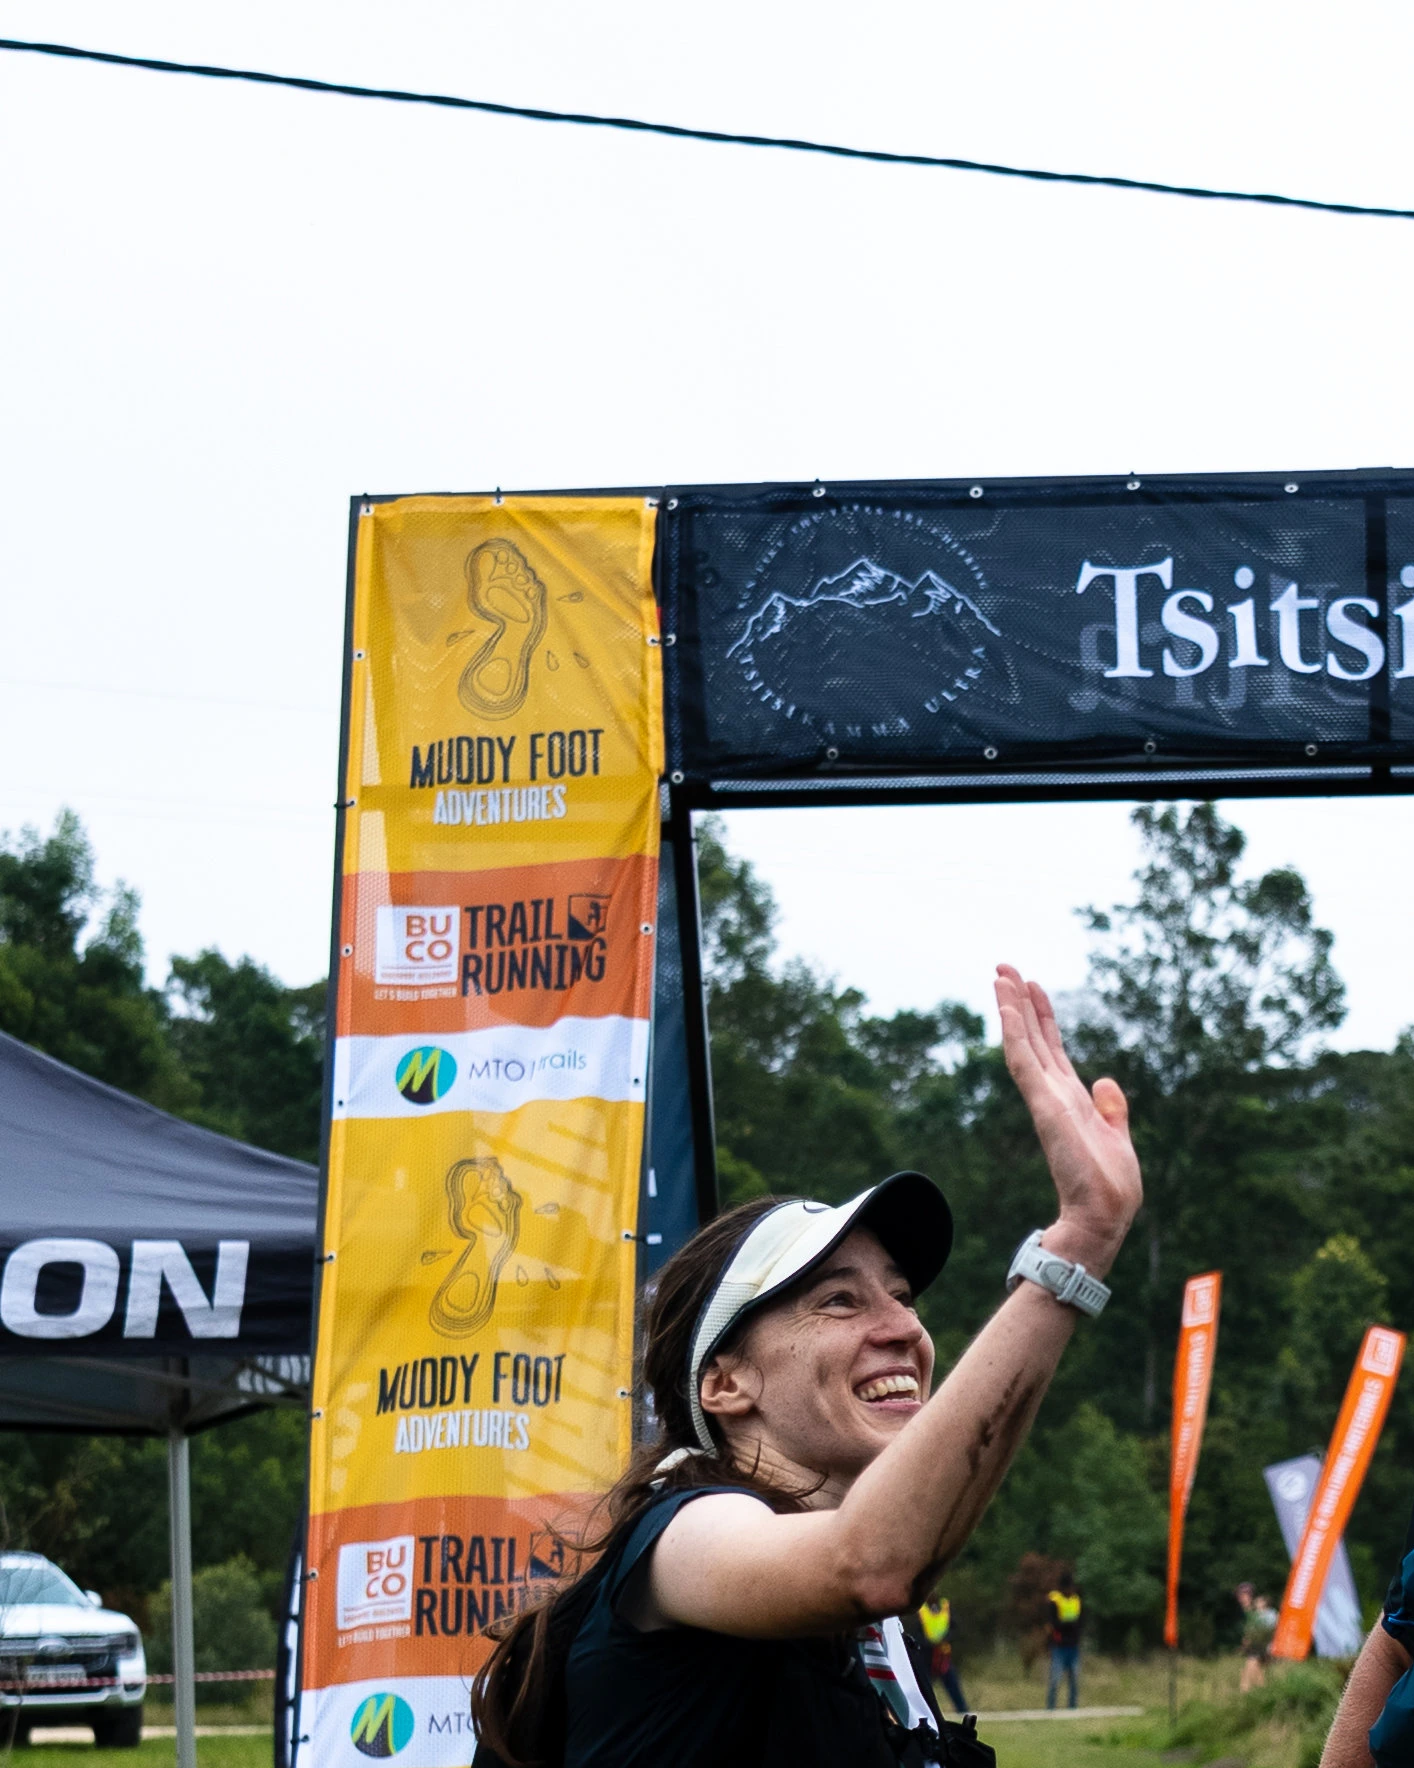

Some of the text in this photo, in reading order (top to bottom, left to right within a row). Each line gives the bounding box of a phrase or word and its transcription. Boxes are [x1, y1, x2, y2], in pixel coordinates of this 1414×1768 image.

[923, 646, 986, 714] ULTRA
[410, 728, 605, 791] MUDDY FOOT
[433, 784, 568, 828] ADVENTURES
[406, 914, 453, 938] BU
[465, 898, 563, 947] TRAIL
[405, 940, 453, 962] CO
[462, 936, 607, 998] RUNNING
[468, 1059, 526, 1082] MTO
[0, 1237, 249, 1341] ON
[376, 1351, 567, 1415] MUDDY FOOT
[394, 1409, 532, 1456] ADVENTURES
[366, 1545, 407, 1575] BU
[418, 1534, 524, 1587] TRAIL
[366, 1573, 407, 1599] CO
[415, 1586, 541, 1638] RUNN
